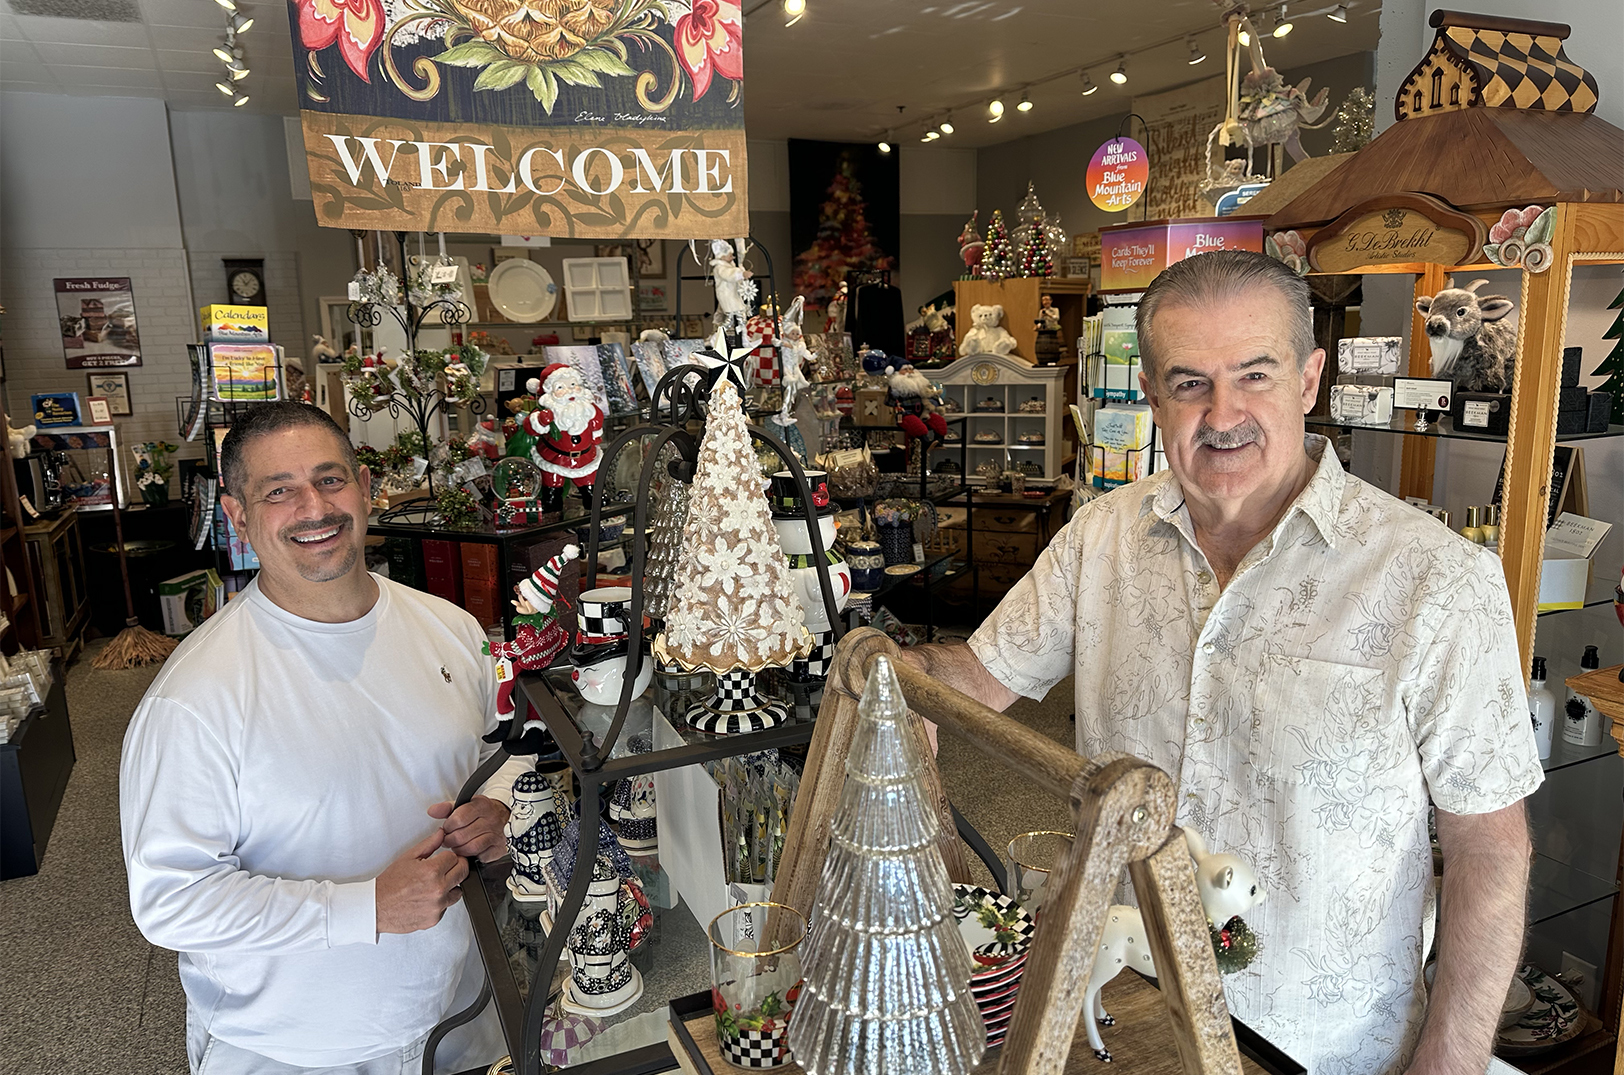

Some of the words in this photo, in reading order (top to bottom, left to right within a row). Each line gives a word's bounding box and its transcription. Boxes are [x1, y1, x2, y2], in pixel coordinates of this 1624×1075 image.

[1107, 142, 1124, 155] NEW
[323, 134, 733, 194] WELCOME
[1101, 151, 1137, 166] ARRIVALS
[1115, 164, 1128, 173] from
[383, 179, 423, 188] TOLAND
[1101, 171, 1126, 184] Blue
[1092, 179, 1142, 199] Mountain
[1105, 193, 1132, 207] Arts
[1193, 233, 1225, 248] Blue
[1111, 246, 1132, 258] Cards
[1132, 244, 1155, 258] They'll
[1111, 258, 1128, 271] Keep
[1128, 256, 1155, 267] Forever
[65, 281, 92, 290] Fresh
[92, 281, 120, 290] Fudge
[214, 310, 265, 321] Calendars
[1565, 520, 1595, 532] BEEKMAN
[1569, 528, 1583, 536] 1802
